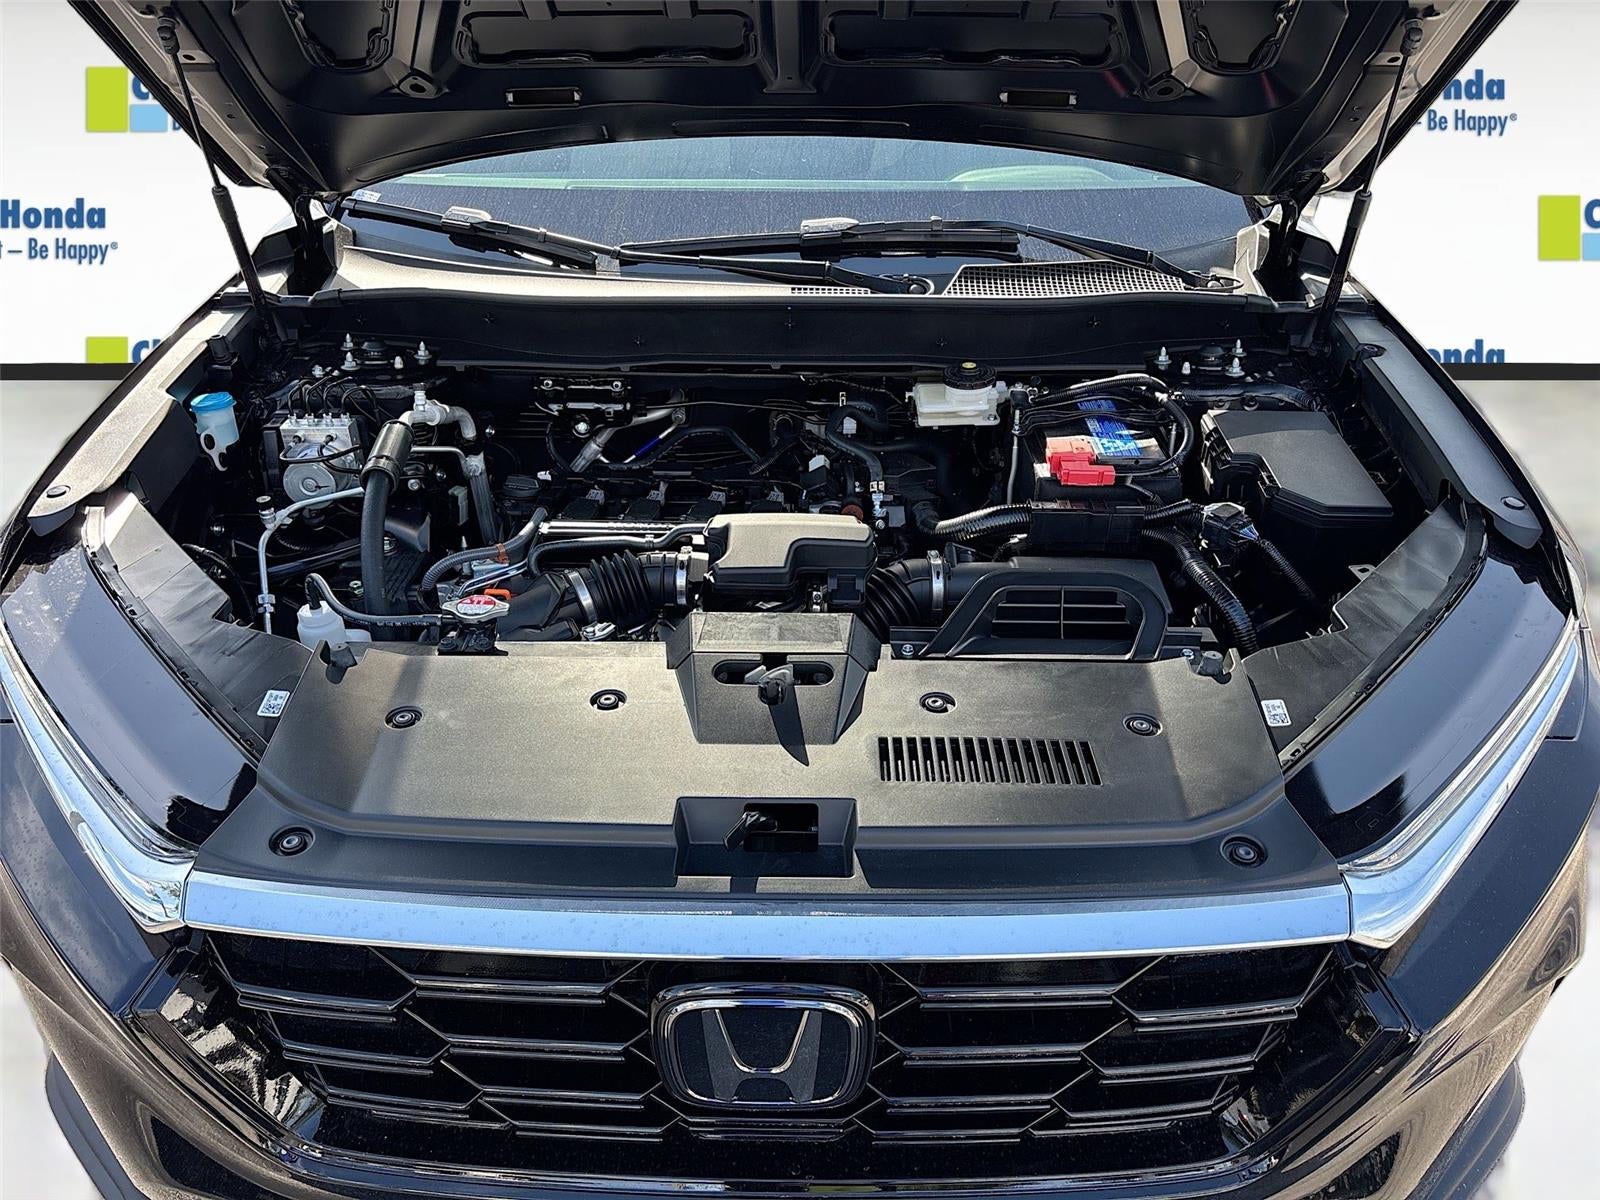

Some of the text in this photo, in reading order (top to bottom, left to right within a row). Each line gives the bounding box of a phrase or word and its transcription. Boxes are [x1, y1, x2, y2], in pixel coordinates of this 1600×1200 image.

[1443, 69, 1505, 100] nda
[1427, 109, 1448, 131] Be
[0, 198, 106, 228] Honda
[28, 238, 49, 260] Be
